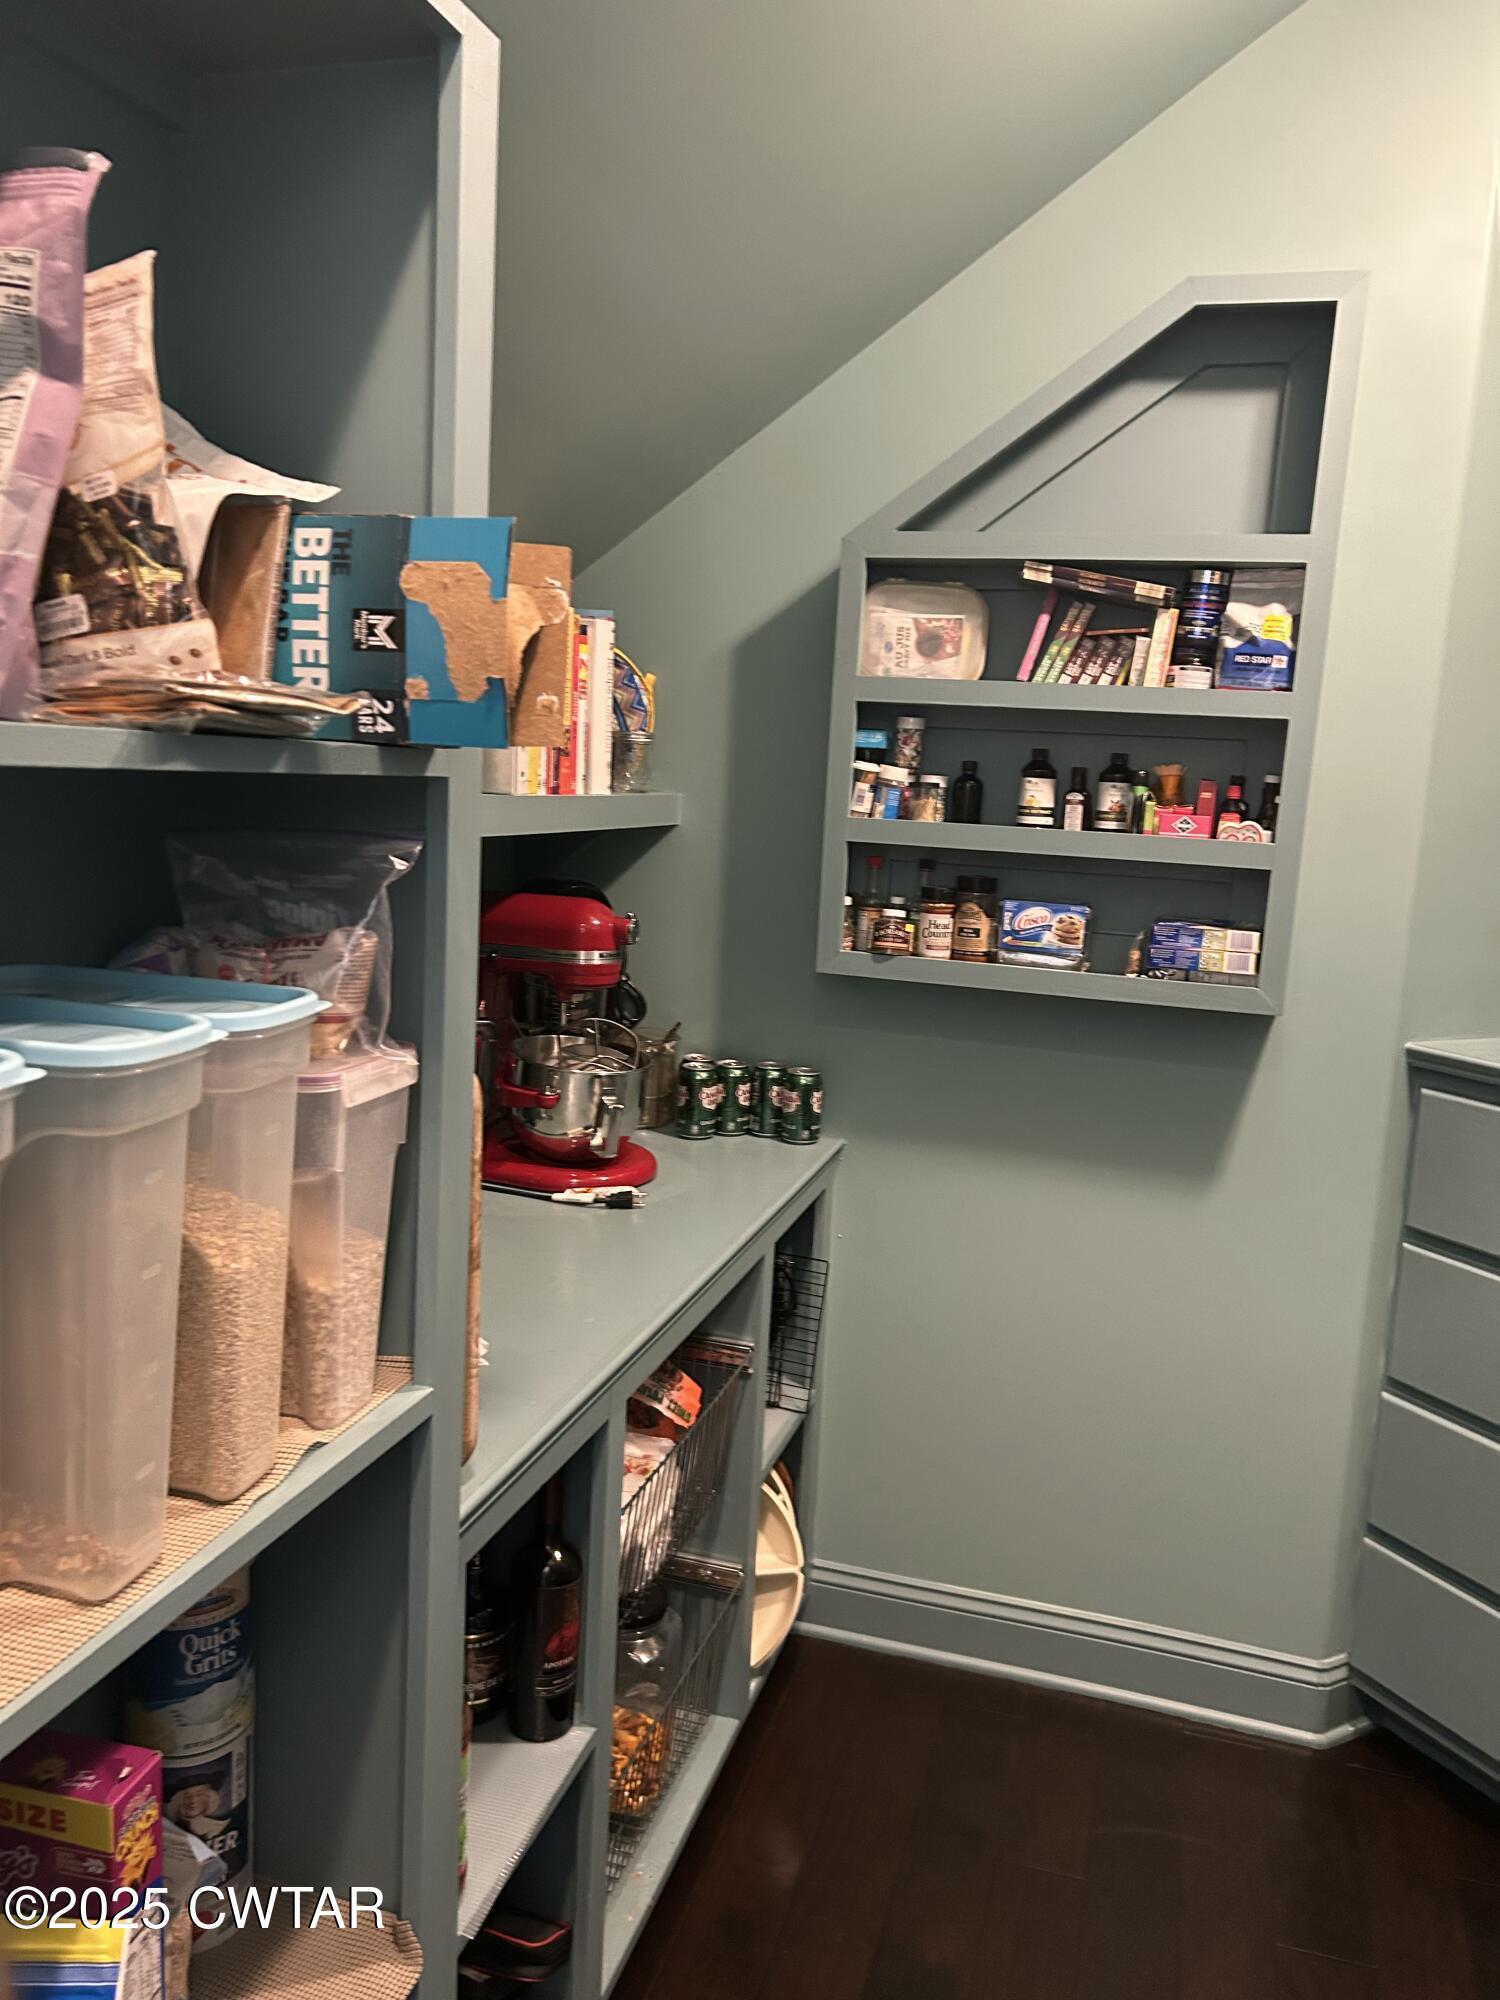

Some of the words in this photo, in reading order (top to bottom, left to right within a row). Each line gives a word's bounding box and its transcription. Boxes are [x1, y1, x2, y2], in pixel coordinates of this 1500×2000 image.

[332, 529, 353, 576] THE
[291, 526, 333, 691] BETTER
[1234, 654, 1250, 663] RED
[1251, 655, 1272, 665] STAR
[373, 698, 396, 734] 24
[180, 1619, 242, 1655] Quick
[185, 1646, 238, 1676] Grits
[0, 1797, 67, 1834] SIZE
